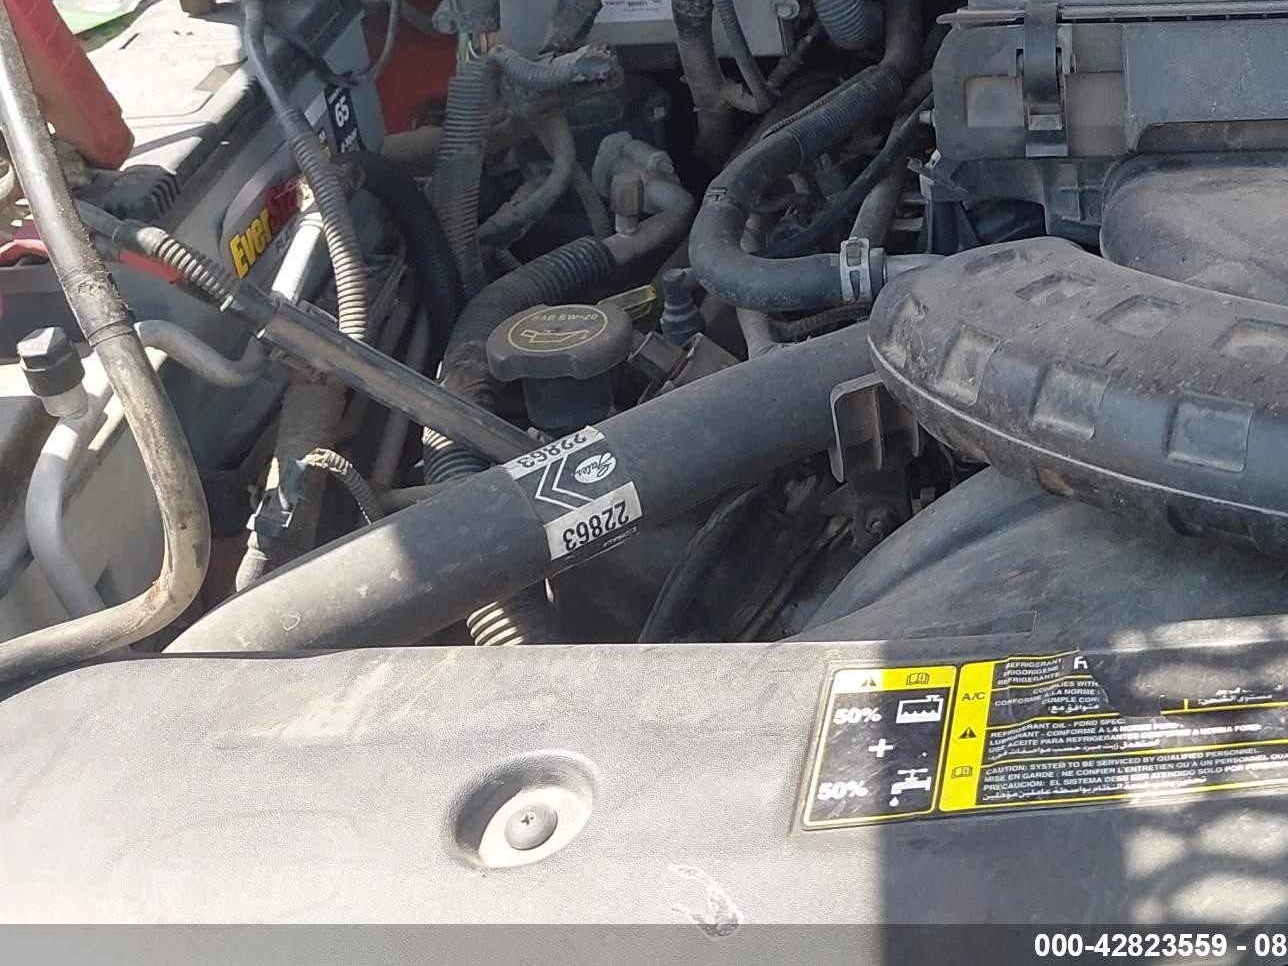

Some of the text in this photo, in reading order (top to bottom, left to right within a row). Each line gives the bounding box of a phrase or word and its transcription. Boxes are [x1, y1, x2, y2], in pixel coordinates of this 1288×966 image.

[335, 95, 350, 128] 65
[558, 313, 598, 322] 5W-20
[562, 500, 630, 552] 22863
[961, 691, 986, 702] A/C
[833, 707, 882, 725] 50%
[1073, 720, 1099, 728] FORD
[1007, 738, 1039, 748] ACEITE
[985, 765, 1028, 775] CAUTION:
[1030, 762, 1066, 771] SYSTEM
[1068, 761, 1080, 769] TO
[1082, 760, 1095, 768] BE
[1096, 757, 1141, 767] SERVICED
[984, 774, 1007, 783] MISE
[1022, 772, 1055, 780] GARDE
[1076, 768, 1116, 776] CONFIER
[1063, 777, 1103, 785] SISTEMA
[1198, 766, 1223, 775] SOLO
[817, 780, 869, 800] 50%
